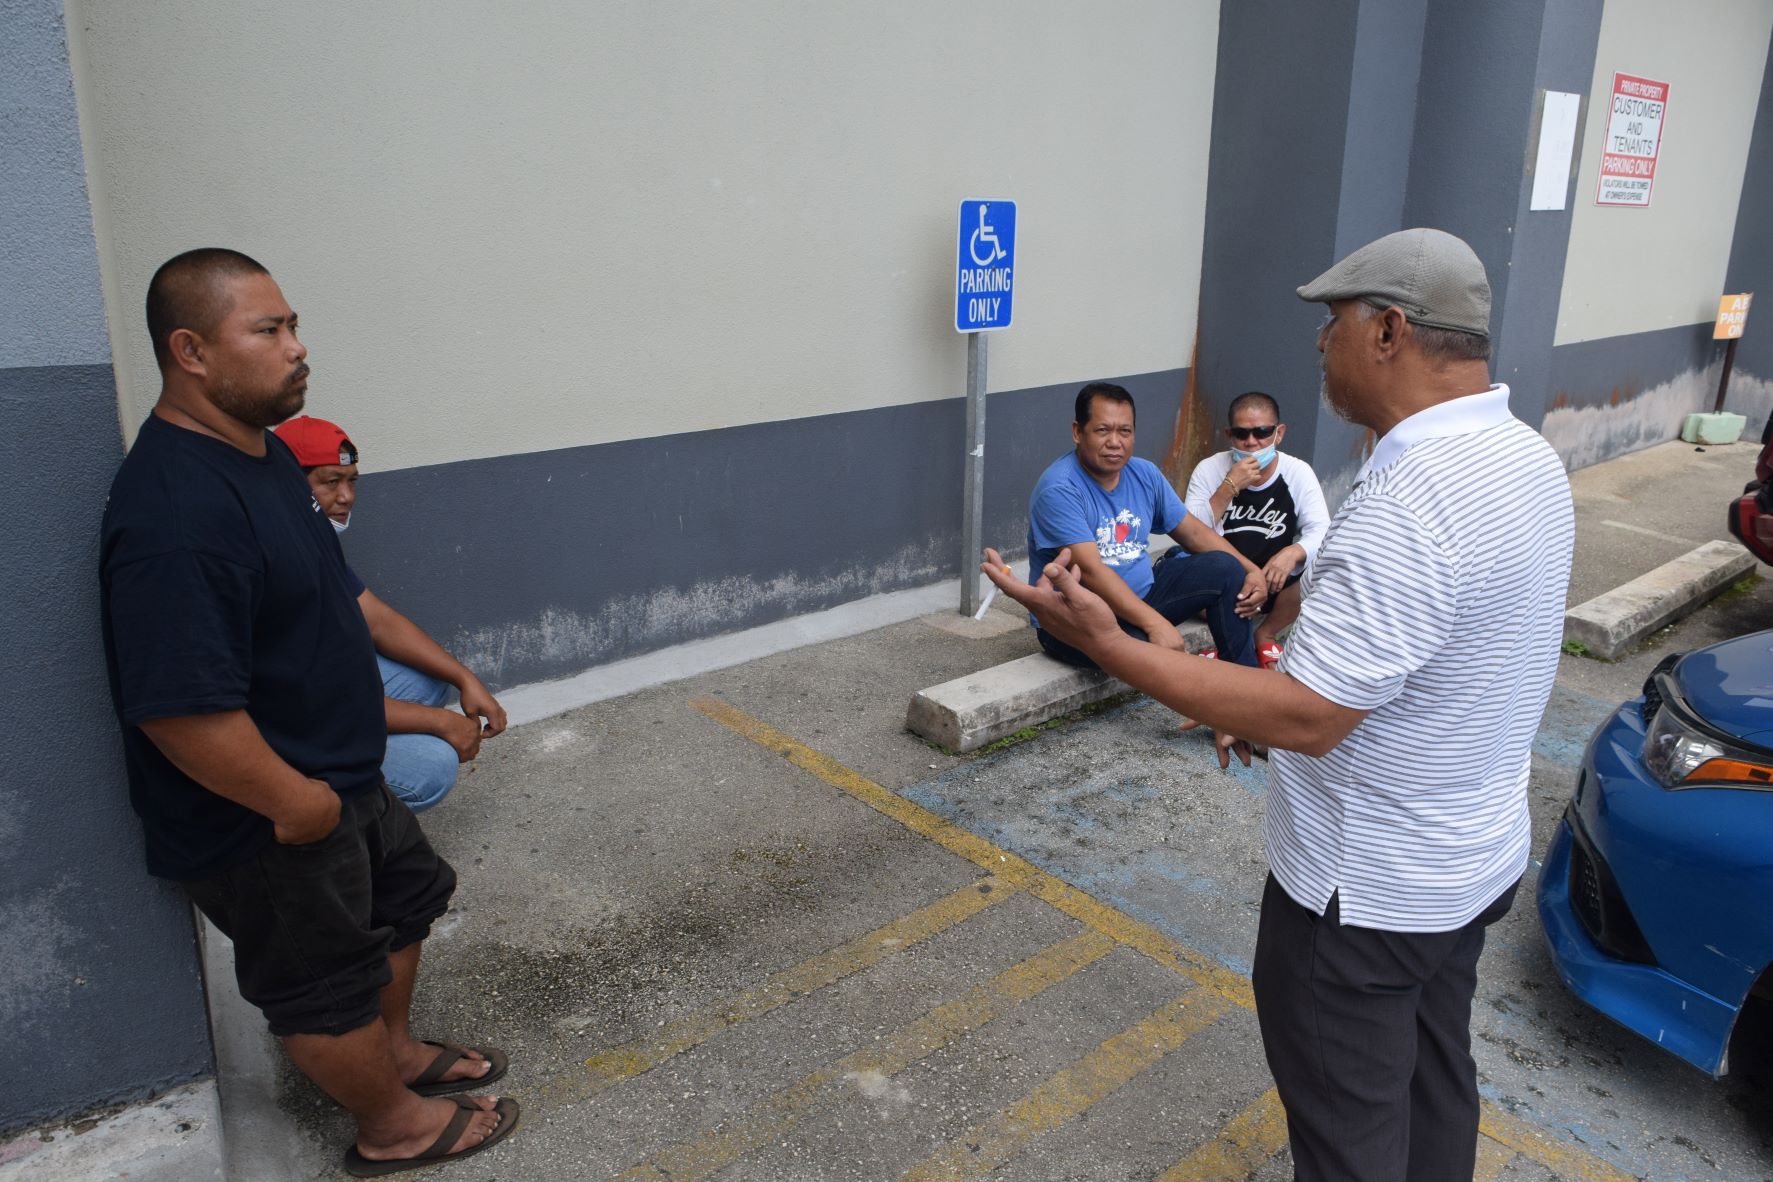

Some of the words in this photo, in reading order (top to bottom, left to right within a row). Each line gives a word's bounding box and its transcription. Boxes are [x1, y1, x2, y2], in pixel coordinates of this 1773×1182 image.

[1621, 80, 1640, 95] PRIVATE
[1639, 83, 1664, 99] PROPERTY
[1613, 96, 1662, 120] CUSTOMER
[1627, 121, 1643, 136] AND
[1613, 135, 1653, 155] TENANTS
[1603, 156, 1635, 174] PARKING
[1634, 159, 1655, 176] ONLY
[960, 267, 1011, 293] PARKING
[968, 298, 1001, 322] ONLY
